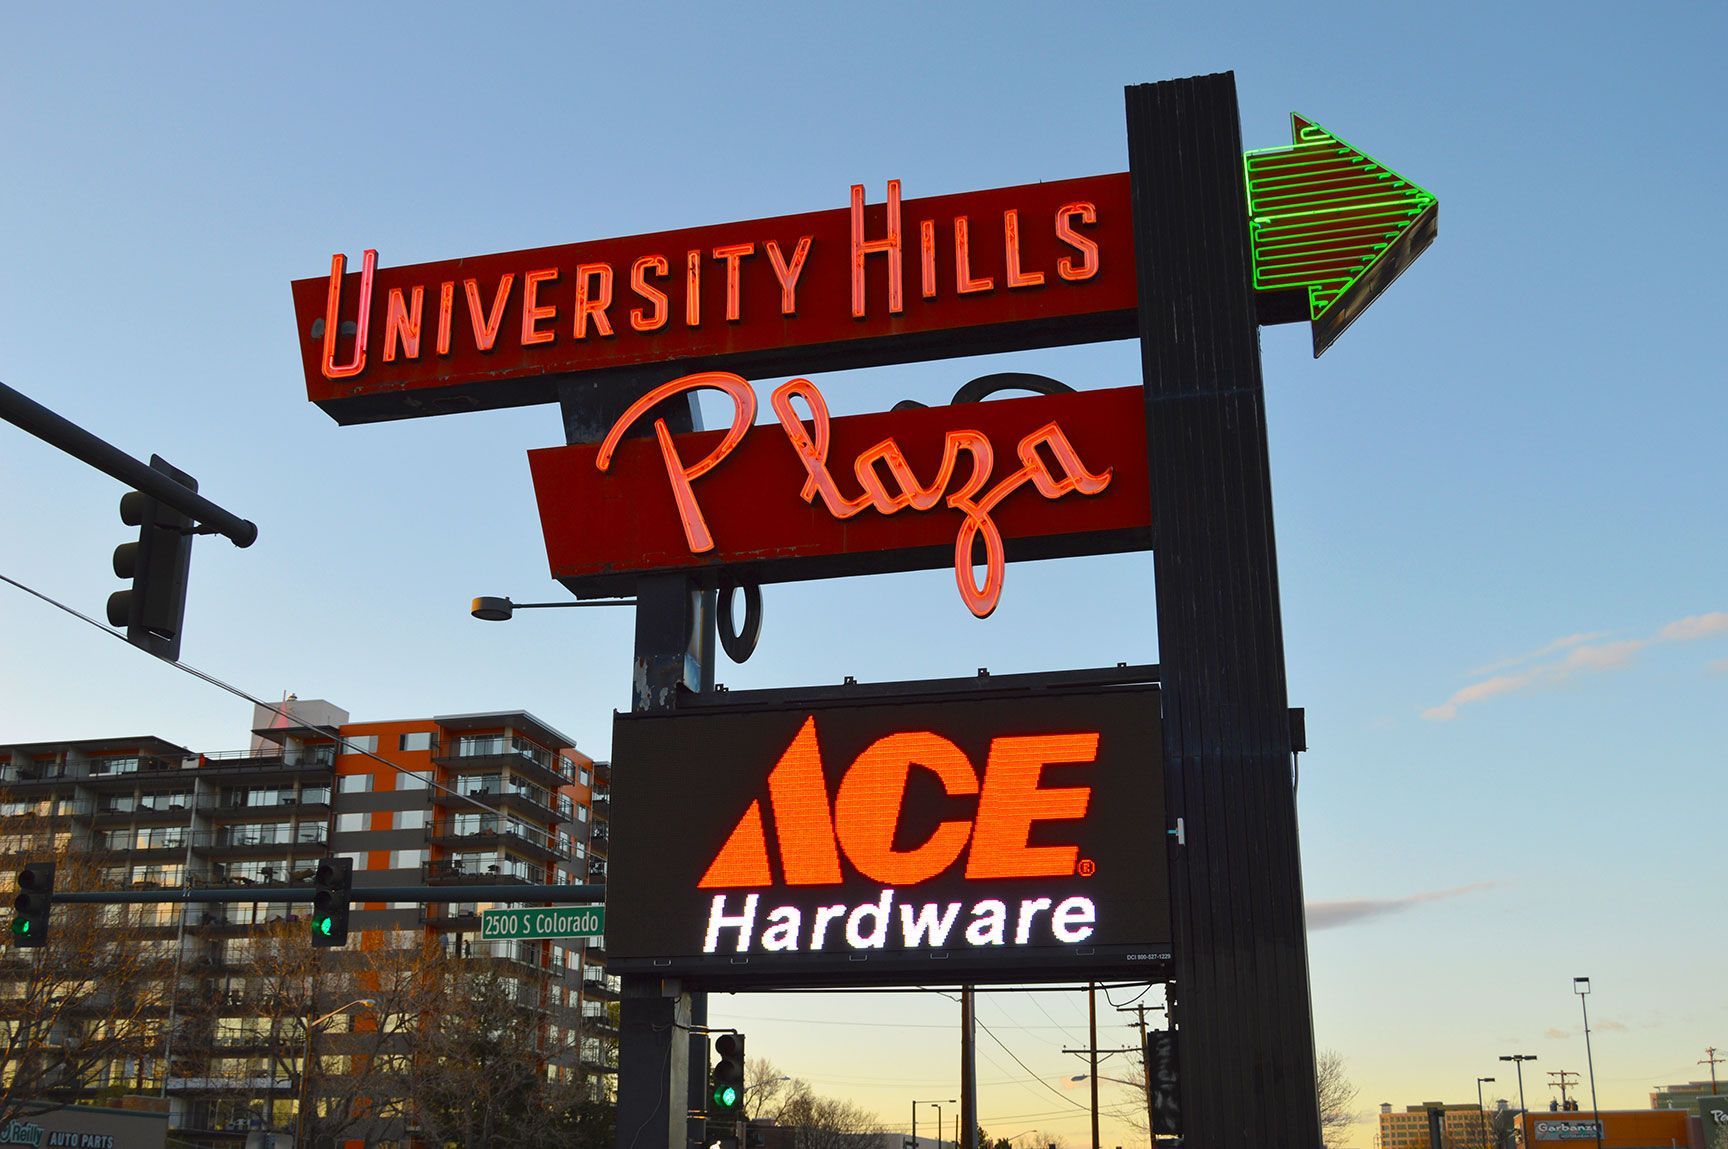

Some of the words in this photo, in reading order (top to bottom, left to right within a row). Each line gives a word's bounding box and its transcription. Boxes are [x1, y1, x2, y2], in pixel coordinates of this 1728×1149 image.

[321, 235, 814, 379] UNIVERSITY
[850, 179, 1100, 319] HILLS
[595, 371, 1114, 619] Plaza
[697, 714, 1100, 888] ACE
[485, 914, 519, 935] 2500
[522, 914, 531, 934] S
[536, 911, 599, 933] Colorado
[703, 888, 1096, 953] Hardware
[49, 1132, 79, 1147] AUTO
[80, 1134, 114, 1149] PARTS
